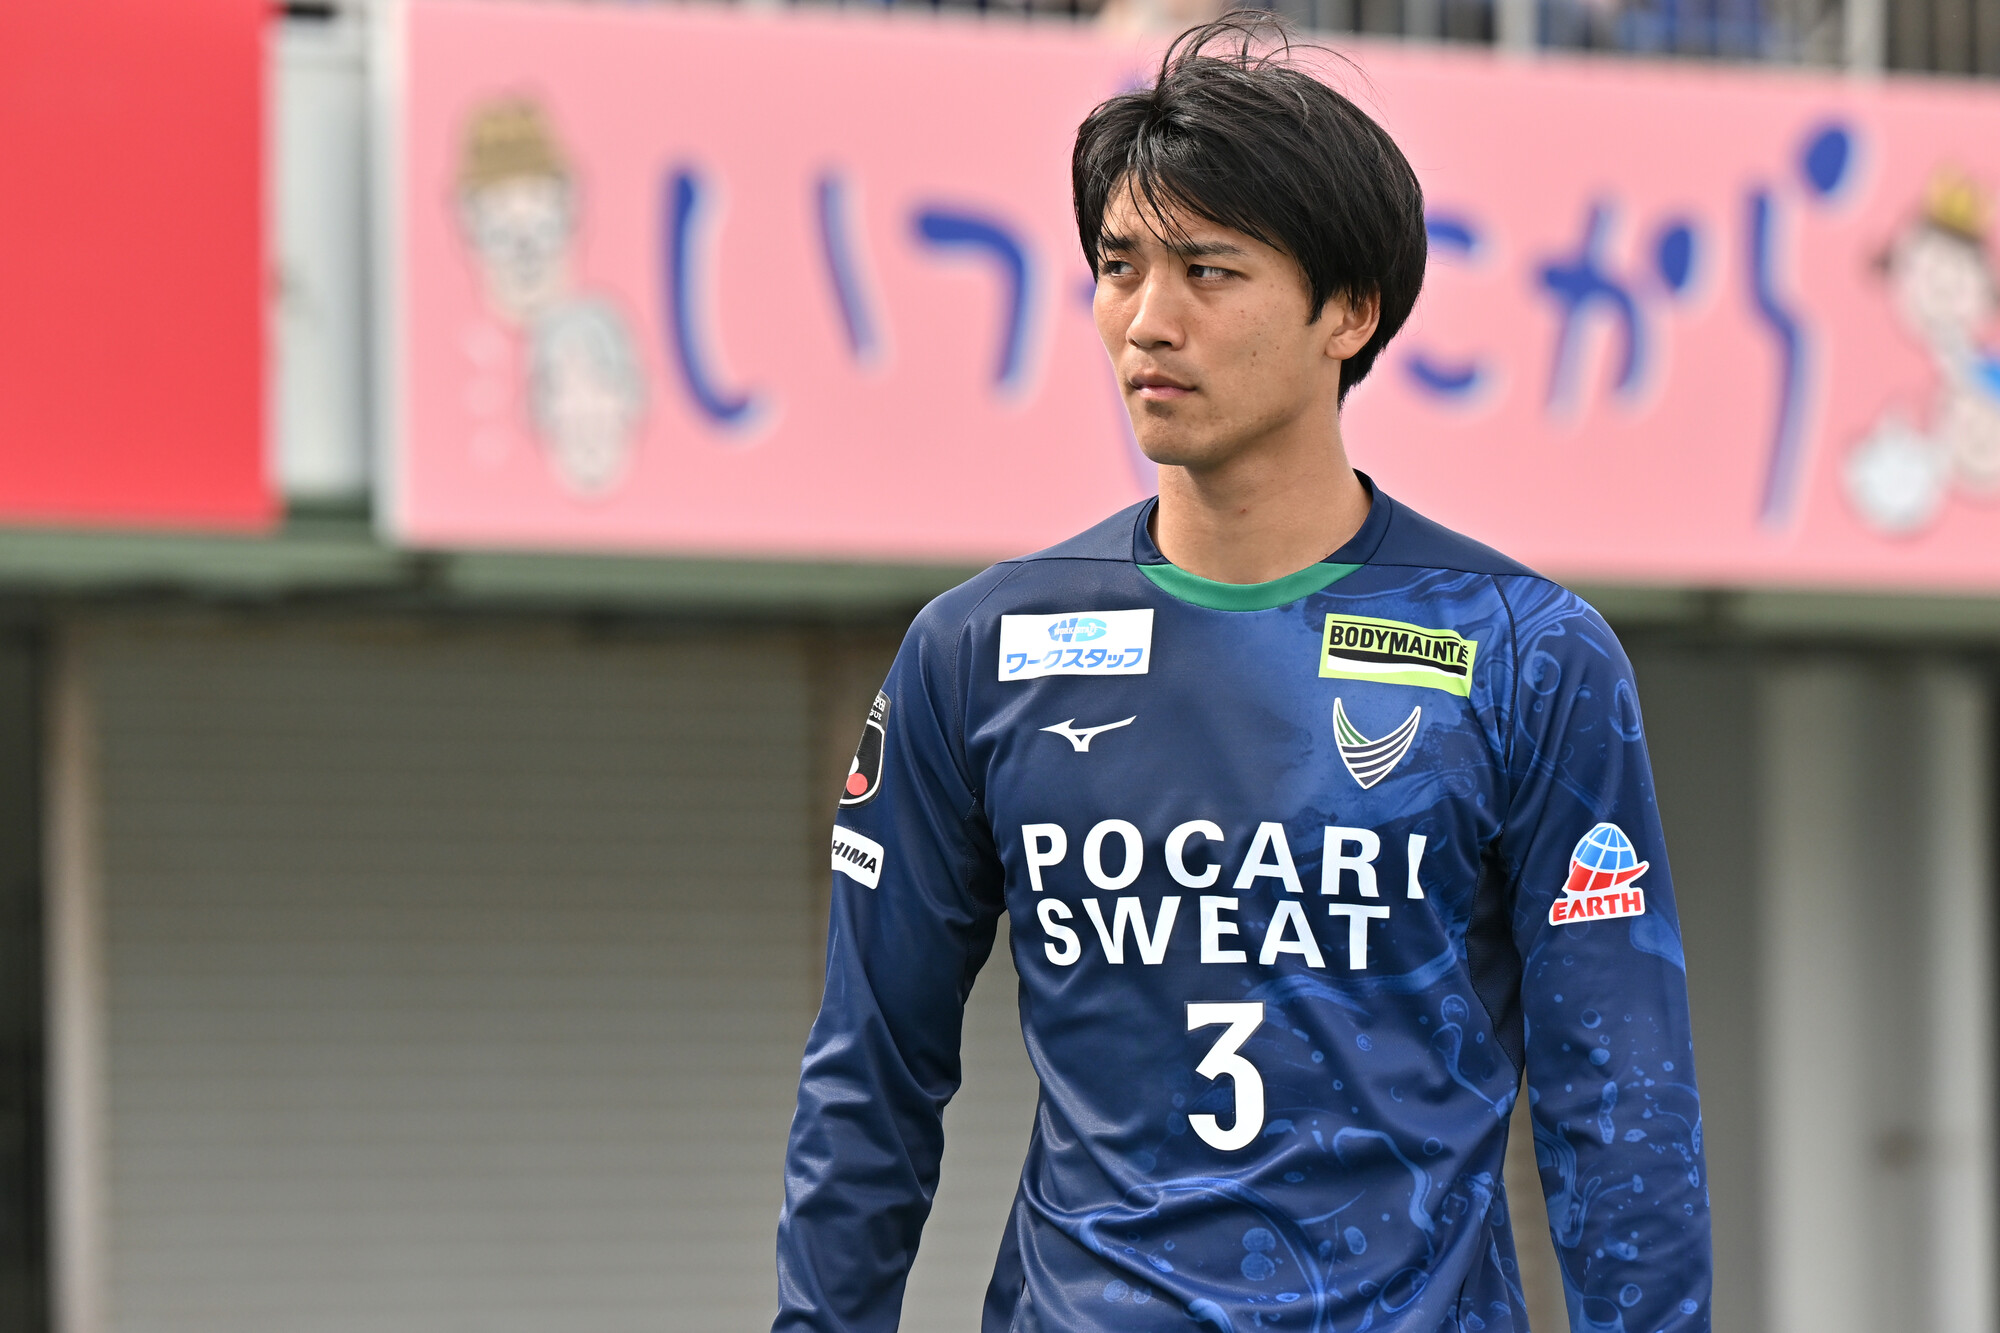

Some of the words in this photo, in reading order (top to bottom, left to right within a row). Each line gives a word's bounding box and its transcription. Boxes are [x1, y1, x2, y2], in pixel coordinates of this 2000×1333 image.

[1006, 648, 1143, 674] ワークスタッフ
[1021, 818, 1427, 899] POCARI
[1036, 895, 1390, 970] SWEAT
[1553, 891, 1641, 922] EARTH
[1187, 1002, 1265, 1151] 3
